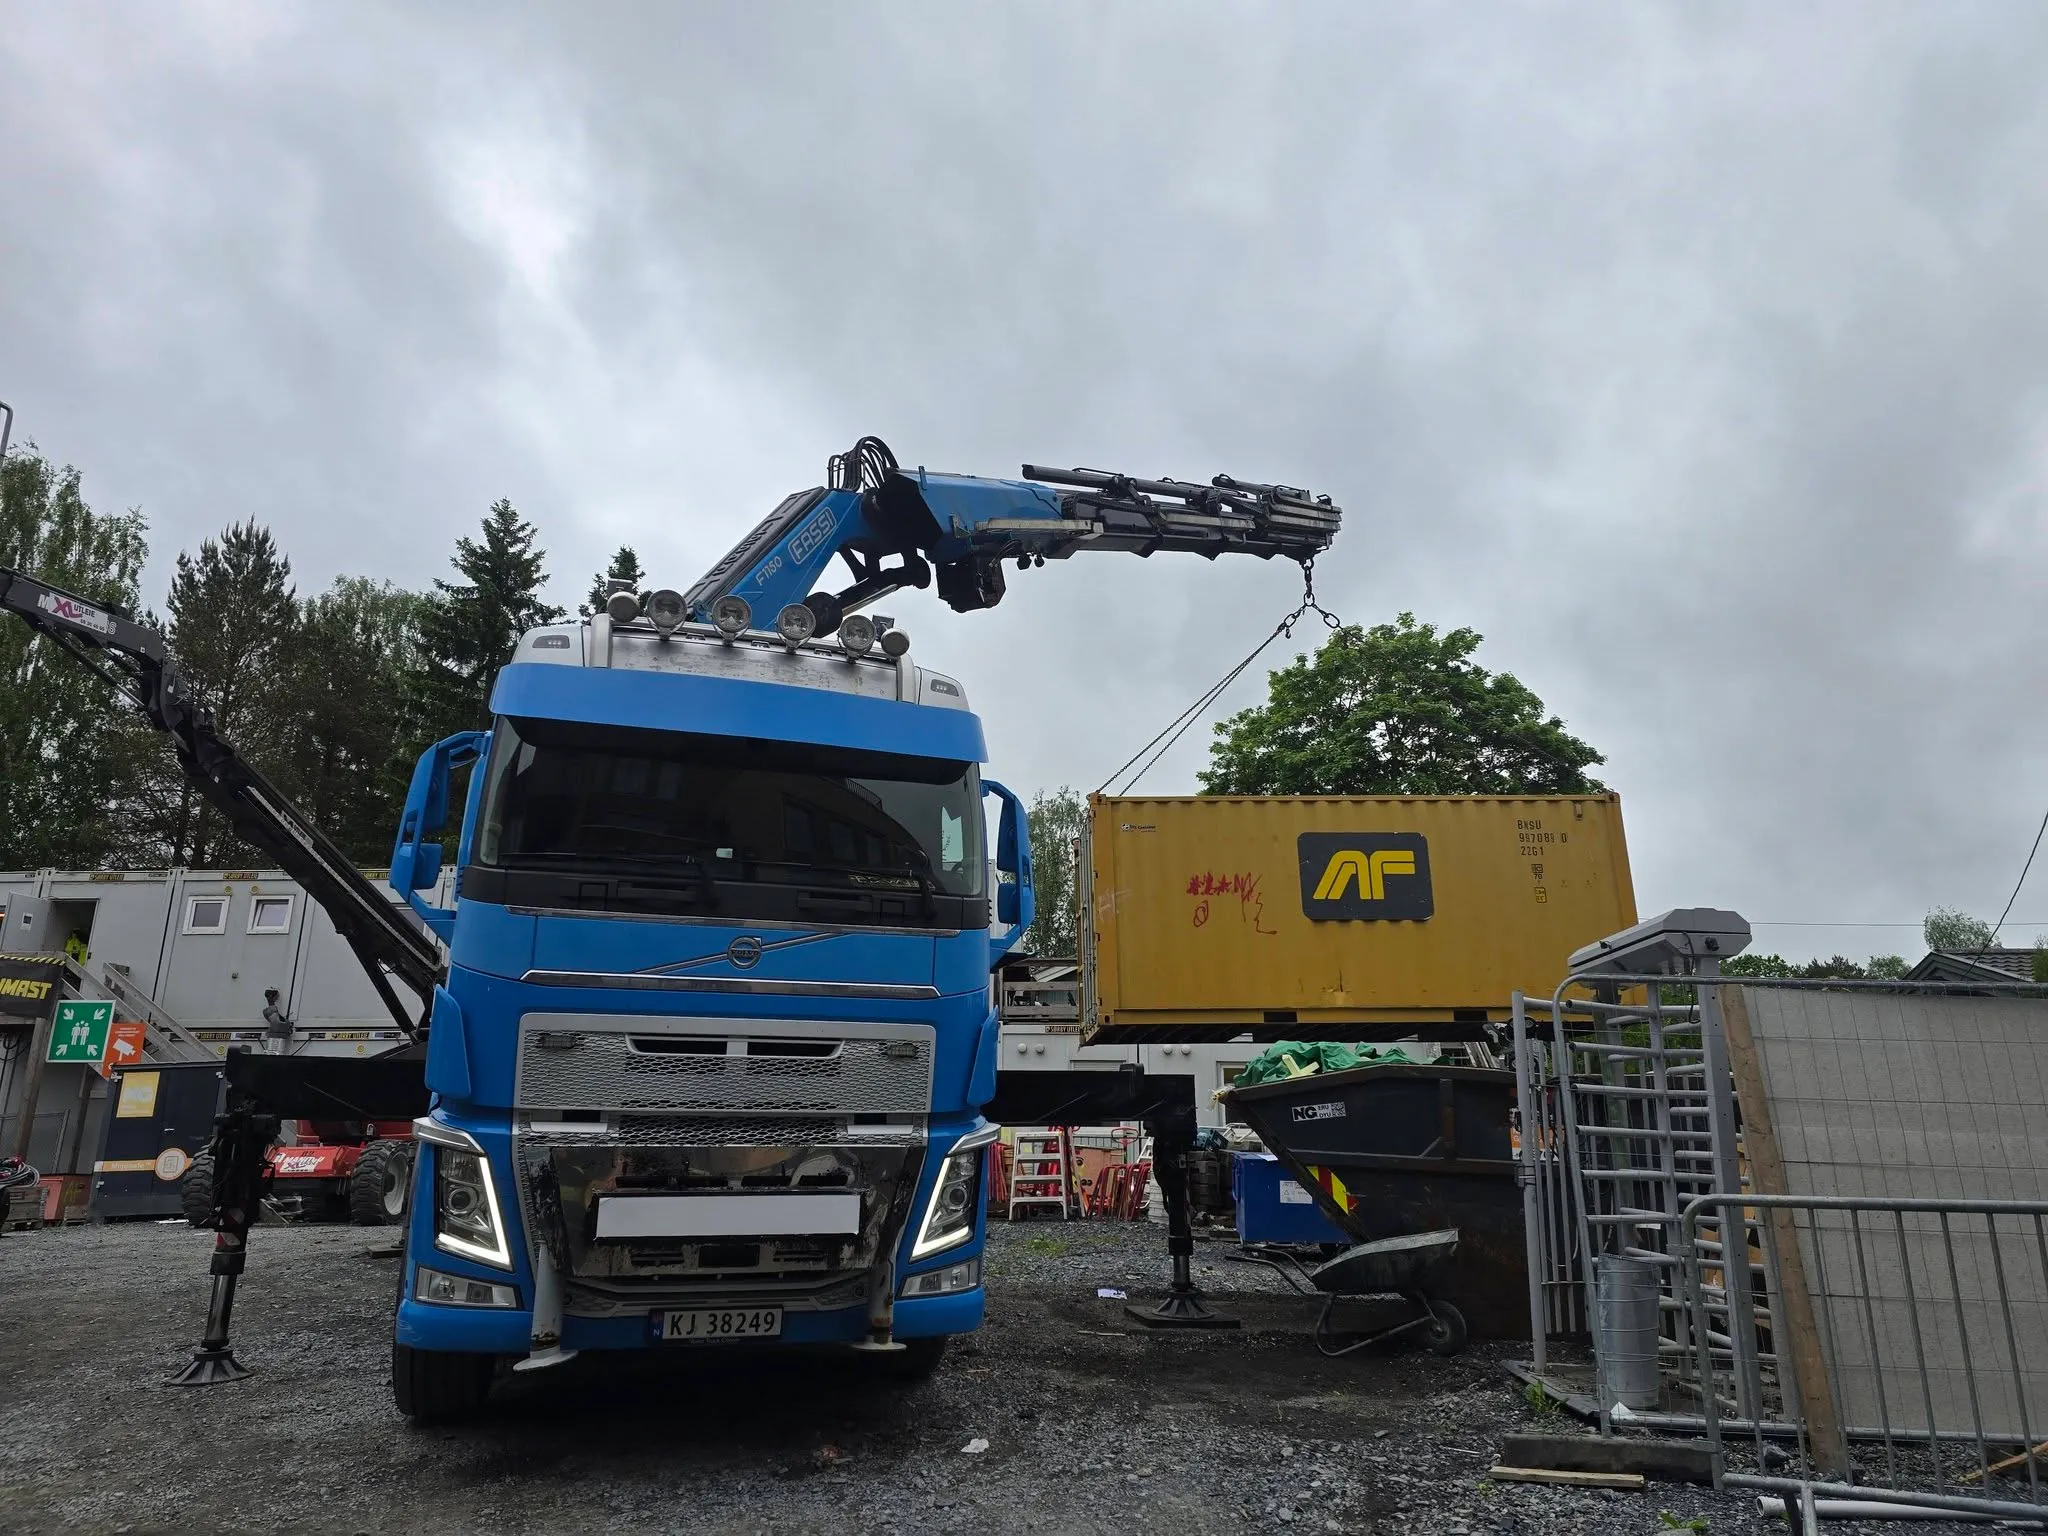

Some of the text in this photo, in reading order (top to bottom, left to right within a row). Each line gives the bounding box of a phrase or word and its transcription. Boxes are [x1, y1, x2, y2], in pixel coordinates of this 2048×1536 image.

[792, 511, 834, 560] FASSI
[756, 556, 782, 586] F1150
[53, 596, 96, 618] XL UTLEIE
[1313, 850, 1416, 900] AF
[0, 977, 53, 1000] MAST
[1293, 1106, 1317, 1120] NG
[669, 1311, 775, 1336] KJ 38249
